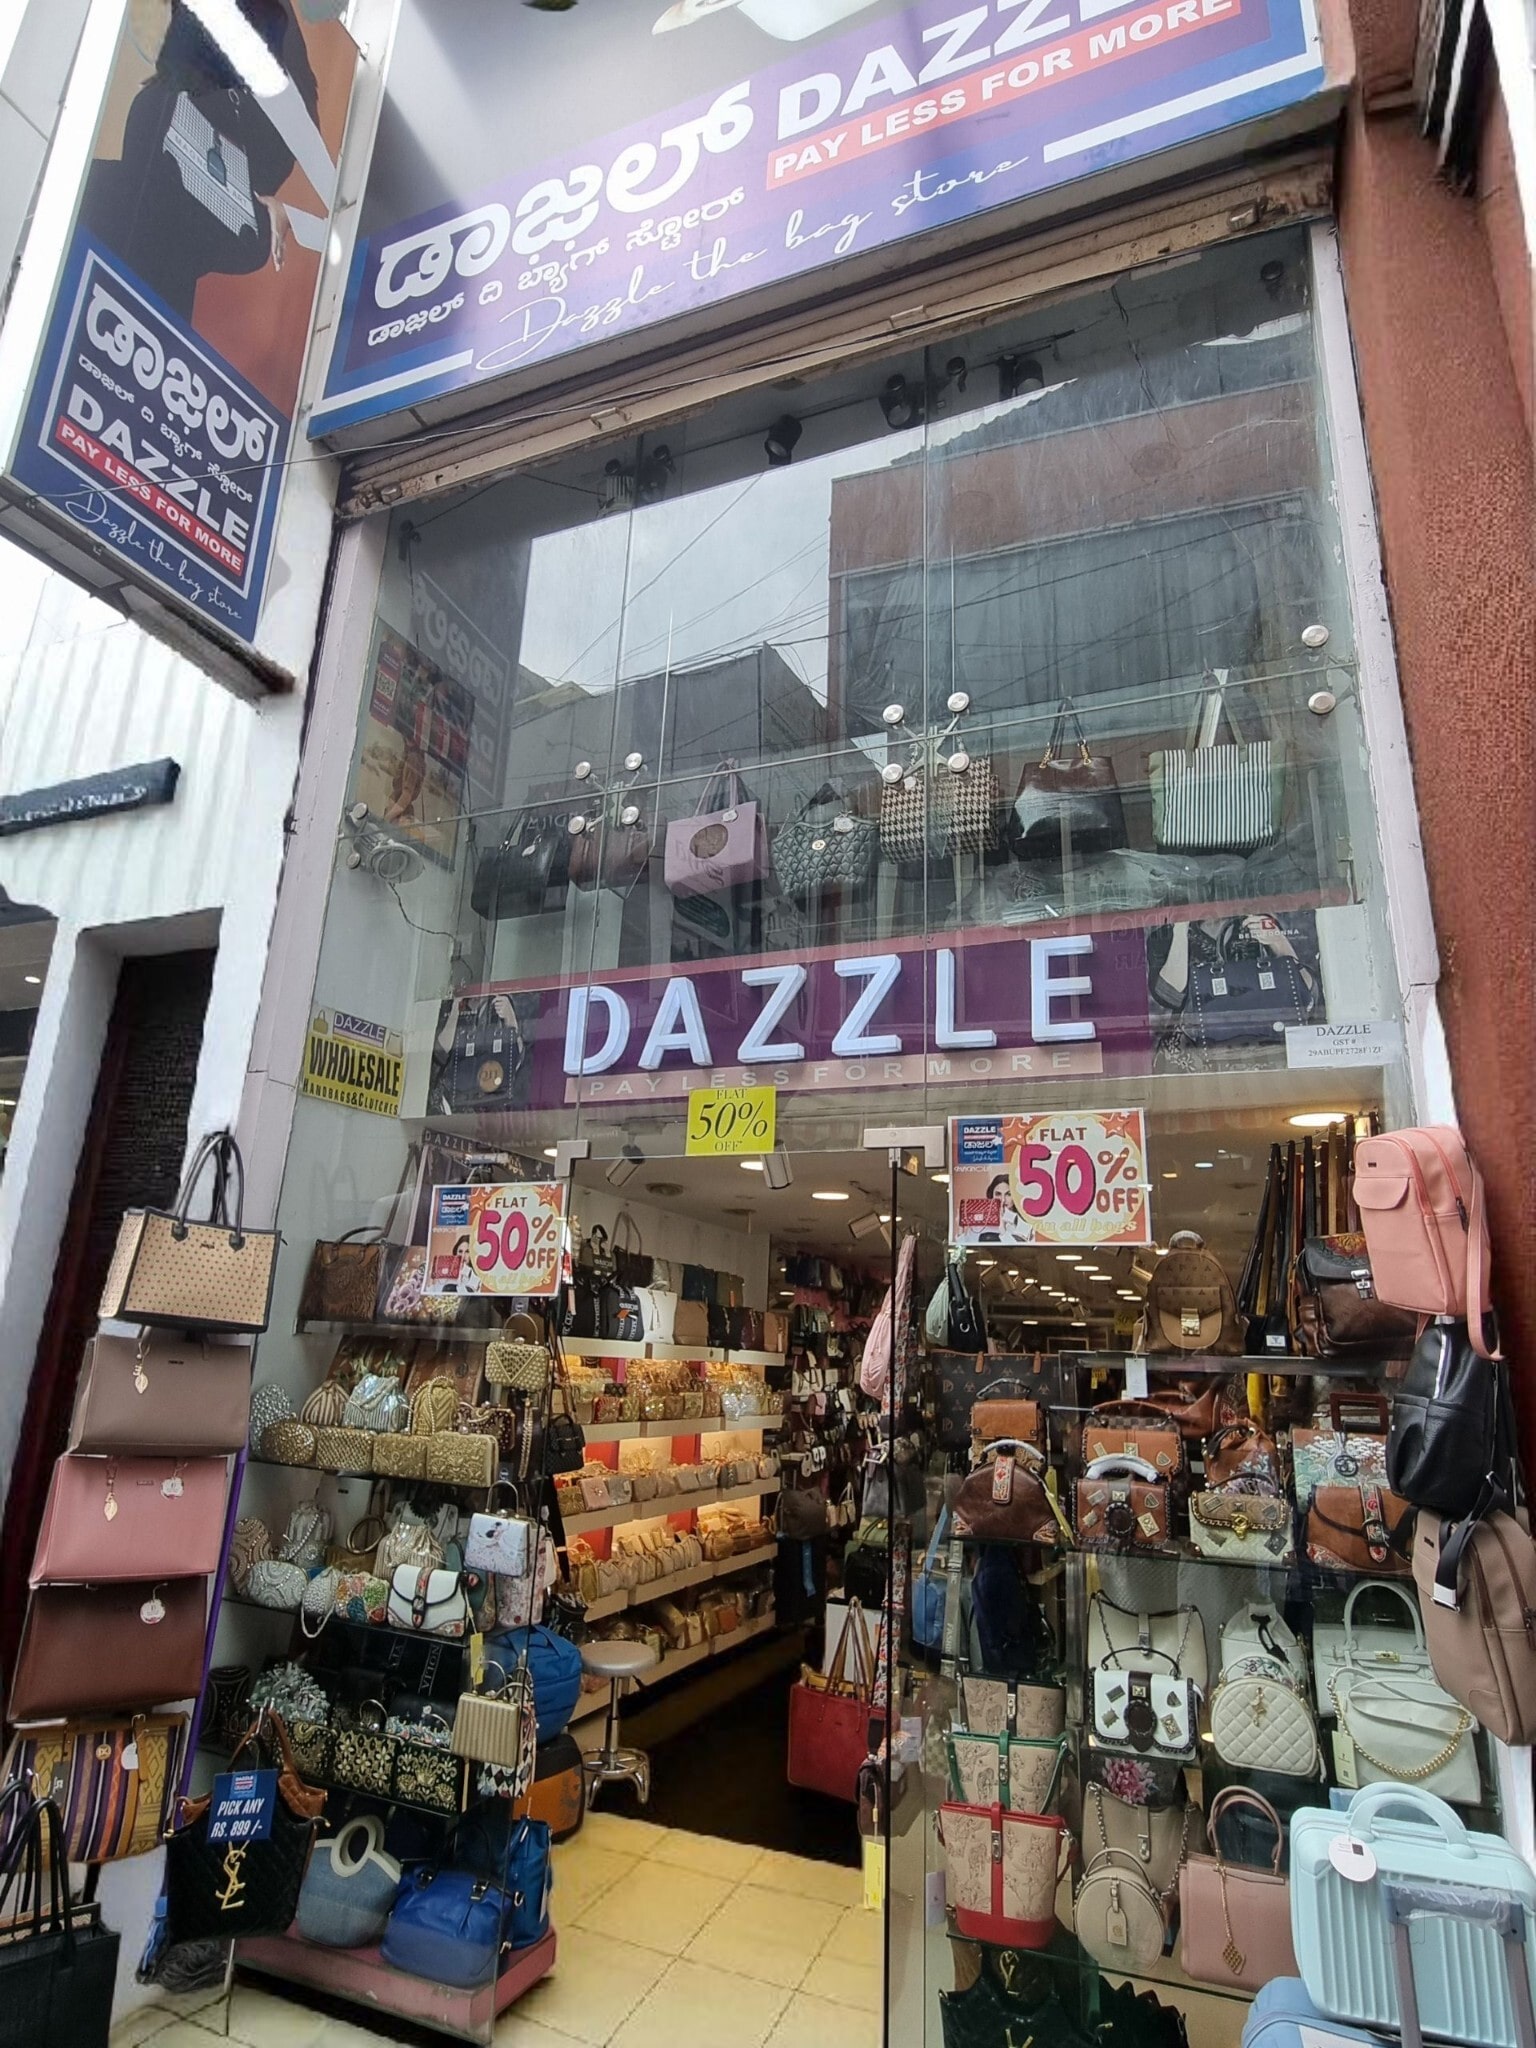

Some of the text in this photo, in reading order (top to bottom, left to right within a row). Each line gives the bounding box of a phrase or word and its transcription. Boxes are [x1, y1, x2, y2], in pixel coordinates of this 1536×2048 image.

[774, 0, 1232, 178] PAY LESS FOR MORE
[476, 156, 1029, 371] Dazzle the bag store
[479, 281, 502, 305] ದಿ
[67, 384, 249, 552] DAZZLE
[61, 424, 243, 570] PAY LESS FOR MORE
[65, 484, 243, 620] Dazzle the bag store
[562, 933, 1096, 1076] DAZZLE
[334, 1013, 386, 1041] DAZZLE
[1316, 1024, 1371, 1037] DAZZLE
[309, 1036, 401, 1097] WHOLESALE
[589, 1052, 1071, 1096] PAY LESS FOR MORE
[716, 1088, 748, 1100] FLAT
[691, 1101, 768, 1140] 50%
[963, 1126, 996, 1134] DAZZLE
[1039, 1127, 1088, 1141] FLAT
[425, 1130, 473, 1153] DAZZLE
[1019, 1144, 1138, 1216] 50%
[495, 1197, 528, 1208] FLAT
[1096, 1188, 1139, 1213] OFF
[476, 1209, 557, 1272] 50%
[526, 1247, 556, 1269] OFF
[217, 1798, 265, 1817] PICK ANY
[210, 1822, 228, 1838] RS.
[230, 1820, 251, 1836] 899
